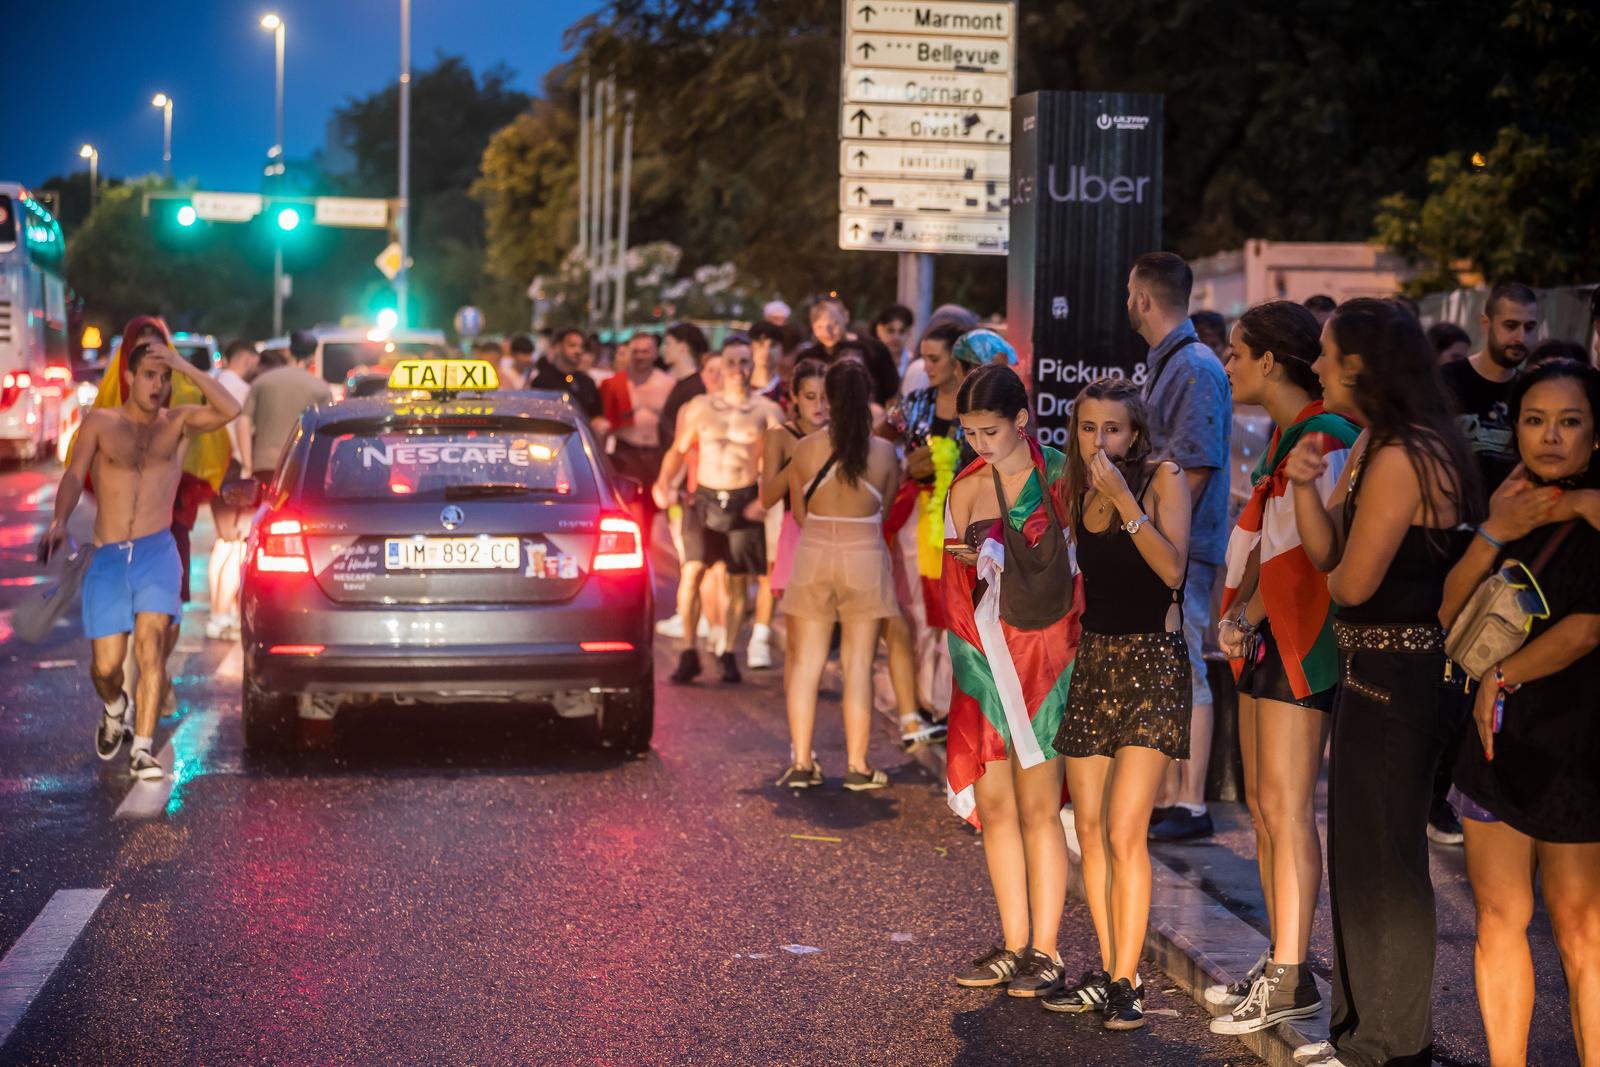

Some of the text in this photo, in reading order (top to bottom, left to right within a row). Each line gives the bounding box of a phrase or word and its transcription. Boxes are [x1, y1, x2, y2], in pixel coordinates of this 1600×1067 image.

[914, 8, 1003, 30] Marmont
[917, 42, 1000, 64] Bellevue
[904, 81, 983, 103] Cornaro
[1048, 164, 1151, 204] Uber
[443, 543, 480, 563] 892
